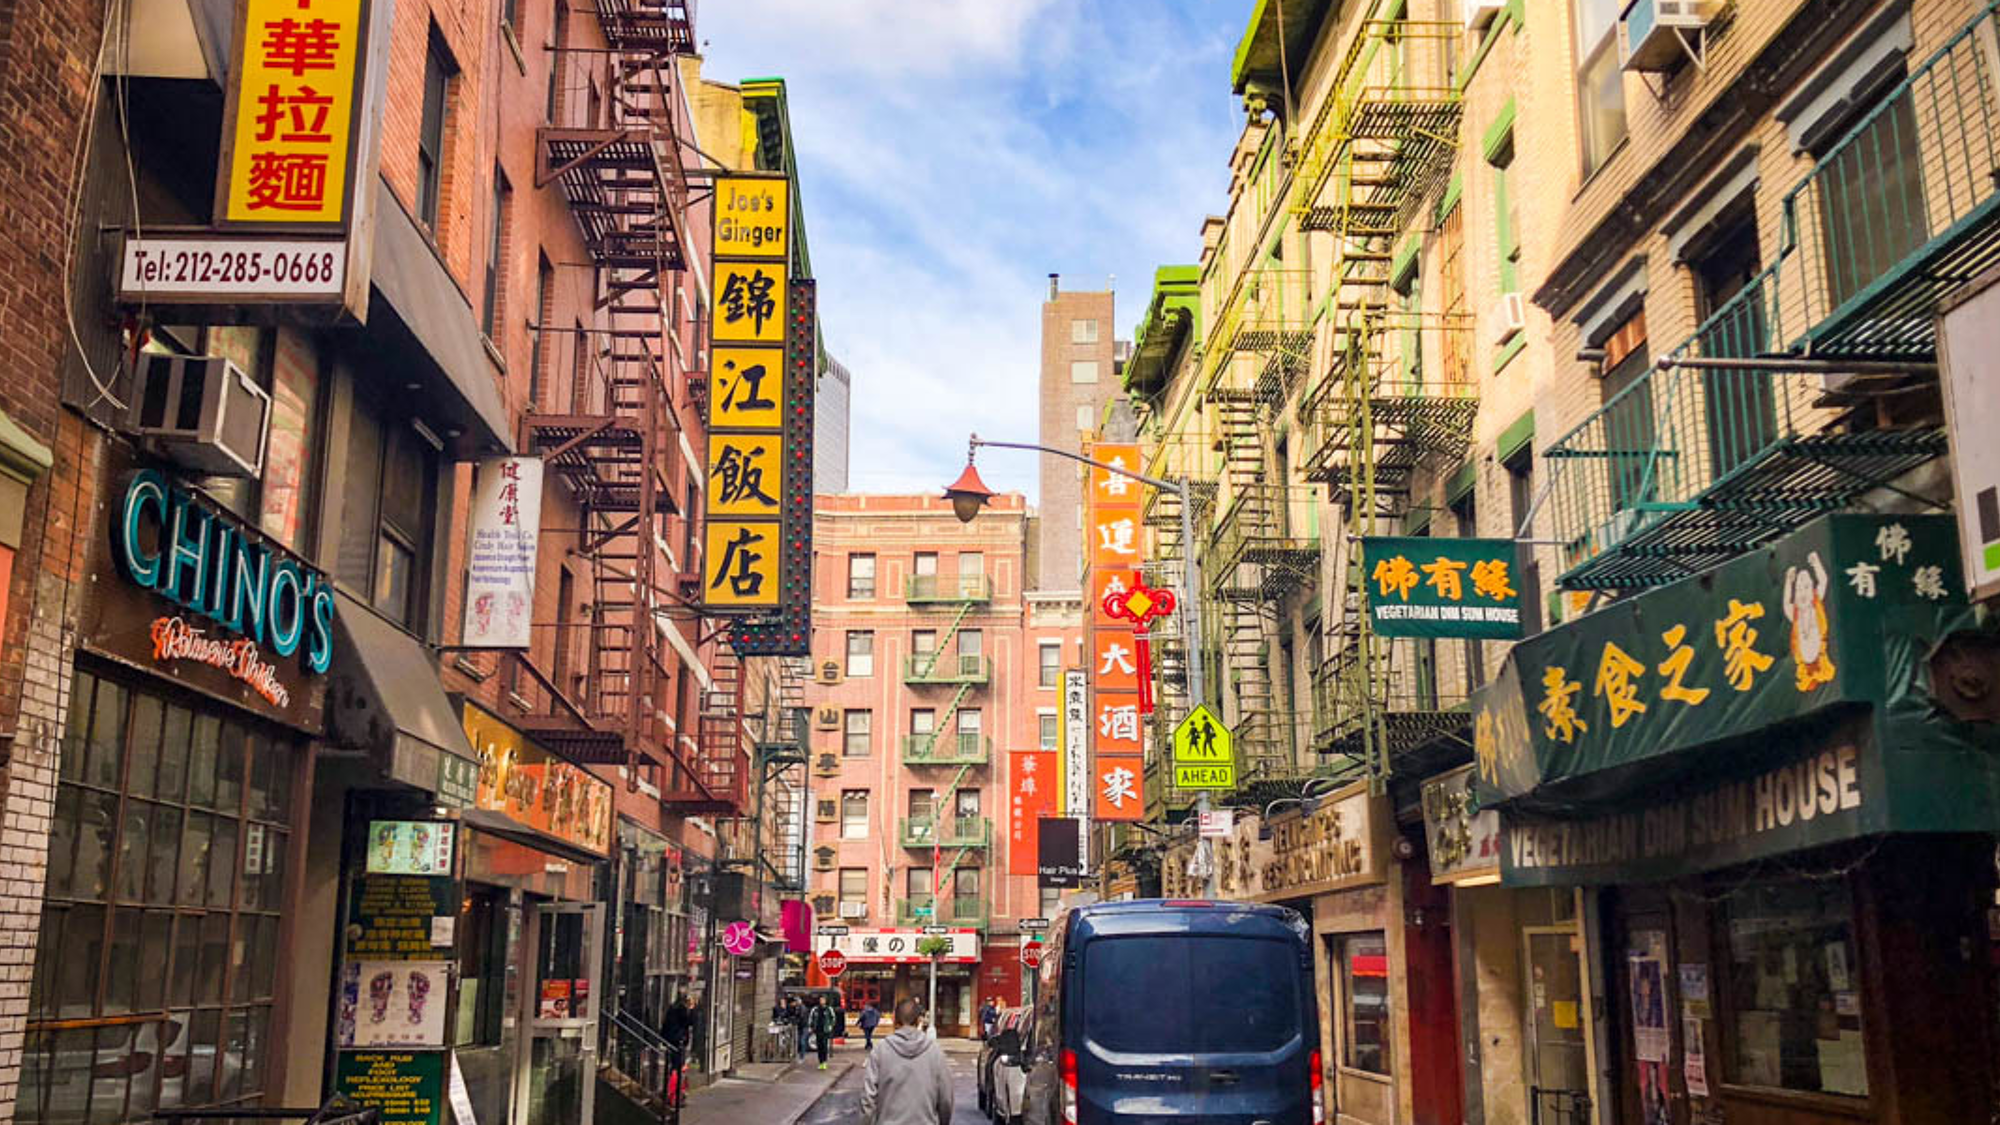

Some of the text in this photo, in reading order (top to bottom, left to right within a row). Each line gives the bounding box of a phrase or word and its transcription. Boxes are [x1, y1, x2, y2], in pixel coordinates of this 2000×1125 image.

[247, 0, 340, 211] 華拉麵
[727, 187, 774, 211] Joe's
[717, 217, 783, 247] Ginger
[710, 268, 778, 597] 錦江飯店
[1875, 522, 1912, 566] 佛
[123, 467, 334, 674] CHINO'S
[1372, 555, 1518, 602] 佛有緣
[1374, 604, 1520, 624] VEGETARIAN DIM SUM HOUSE
[1537, 598, 1776, 744] 素食之家
[1180, 769, 1228, 783] AHEAD
[1754, 744, 1863, 832] HOUSE
[821, 957, 845, 969] STOP
[1116, 1073, 1166, 1081] TRANSIT
